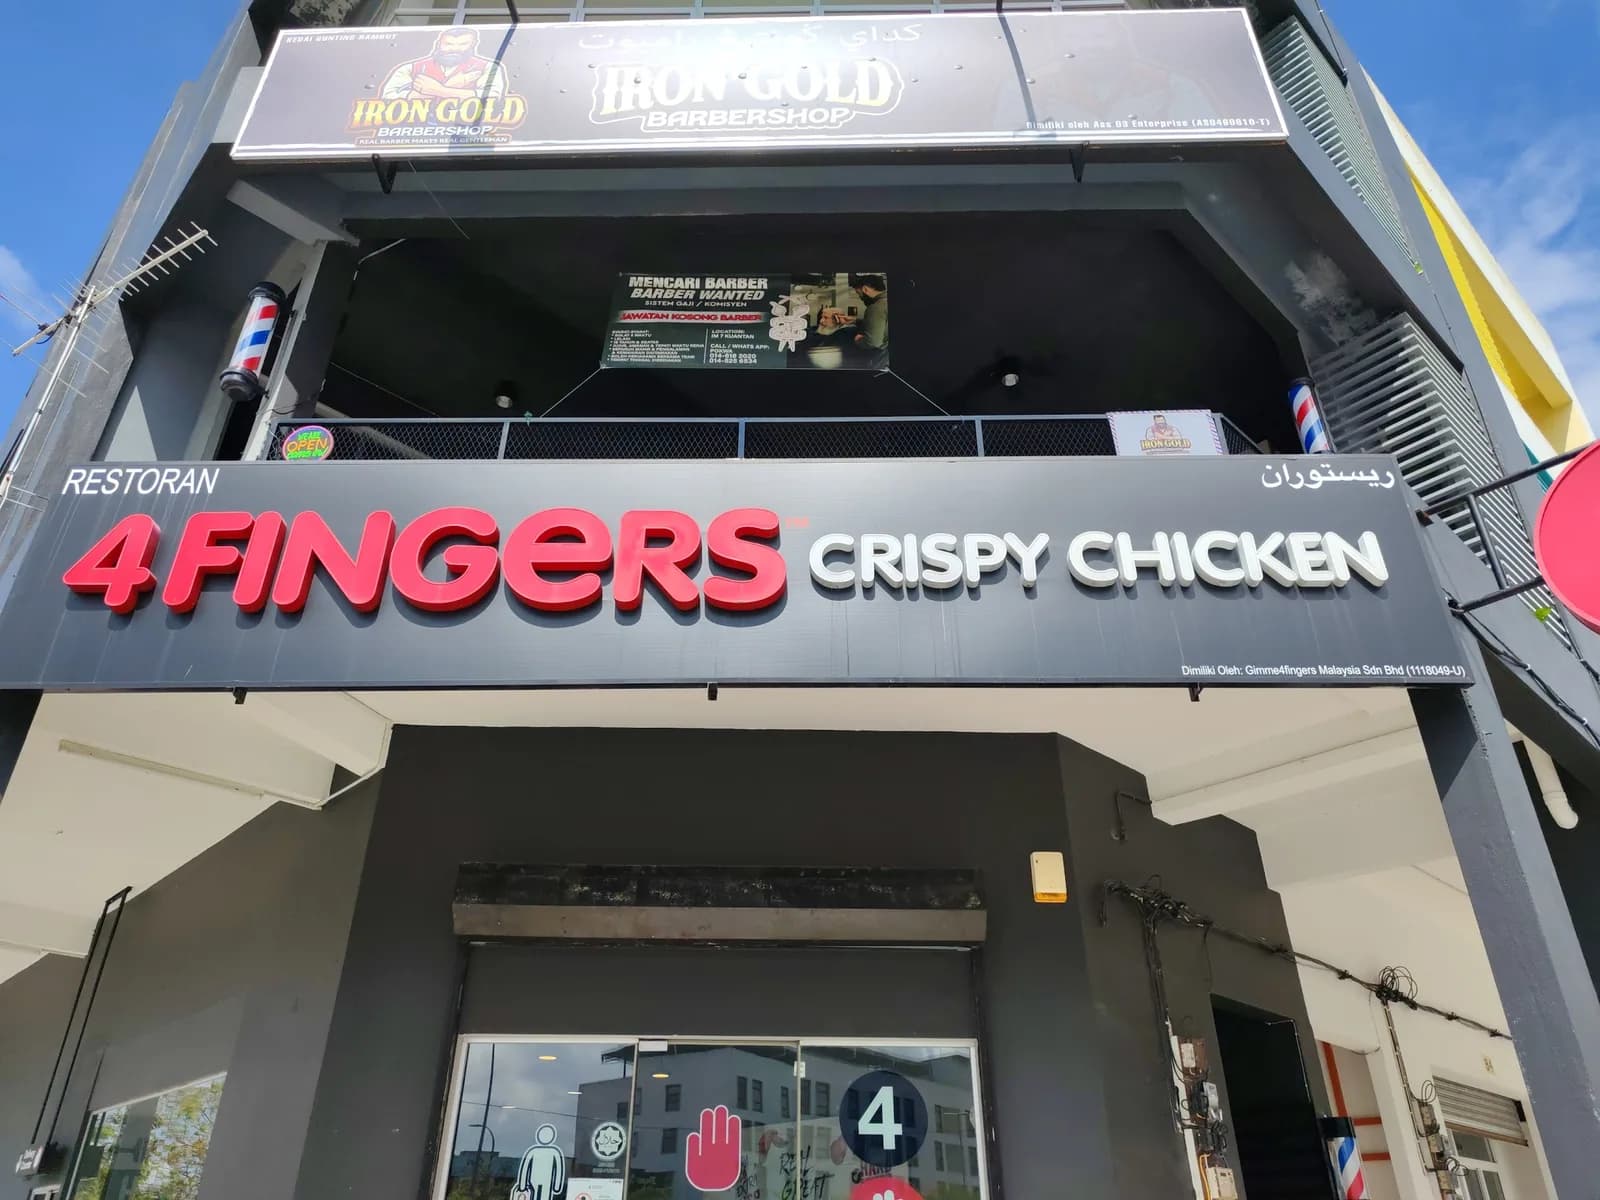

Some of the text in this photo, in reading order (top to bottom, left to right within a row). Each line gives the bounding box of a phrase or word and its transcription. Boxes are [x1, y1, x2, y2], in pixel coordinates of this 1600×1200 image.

[600, 59, 894, 115] IRON GOLD
[353, 96, 526, 128] IRON GOLD
[646, 107, 852, 128] BARBERSHOP
[1132, 119, 1188, 129] Enterprise
[377, 126, 493, 137] BARBERSHOP
[628, 276, 768, 290] MENCARI BARBER
[630, 288, 765, 301] BARBER WANTED
[620, 312, 762, 321] JAWATAN KOSONG BARBER
[287, 438, 328, 452] OPEN
[1141, 439, 1191, 449] IRON GOLD
[61, 467, 220, 495] RESTORAN
[1261, 463, 1395, 489] ريستوران
[808, 532, 1050, 590] CRISPY
[1066, 530, 1389, 588] CHICKEN
[1181, 665, 1466, 677] Dimiliki Oleh: Gimme4fingers Malaysia Sdn Bhd (1118049-U)
[858, 1086, 903, 1150] 4
